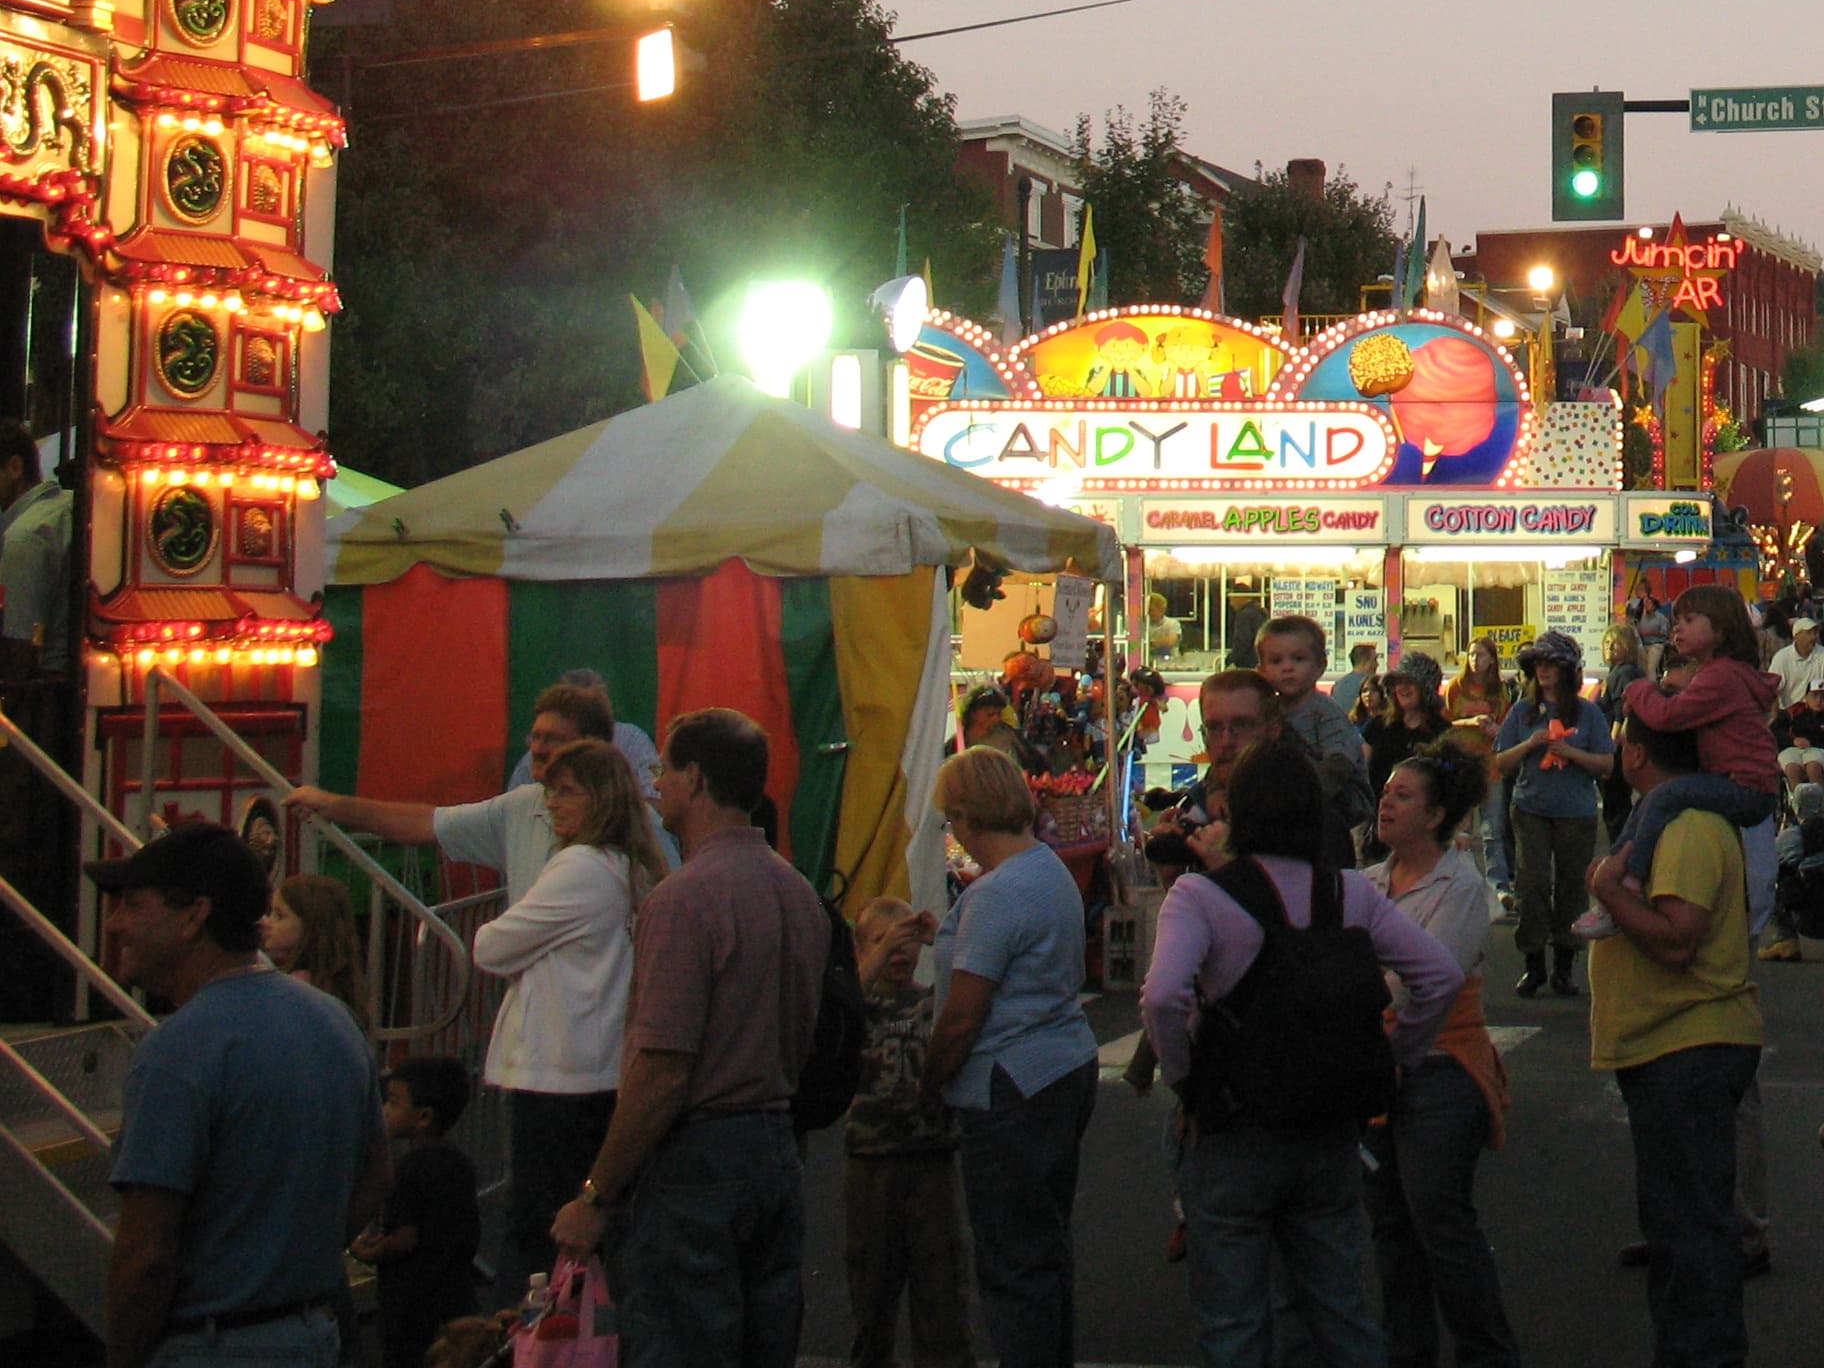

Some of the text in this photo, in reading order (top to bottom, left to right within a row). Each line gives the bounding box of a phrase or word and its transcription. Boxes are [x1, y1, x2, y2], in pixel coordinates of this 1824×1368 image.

[1711, 96, 1794, 122] Church
[1612, 235, 1744, 277] Jumpin'
[943, 419, 1364, 471] CANDY LAND
[1146, 506, 1379, 534] CARAMEL APPLES CANDY
[1424, 505, 1597, 534] COTTON CANDY
[1355, 595, 1377, 609] SNO
